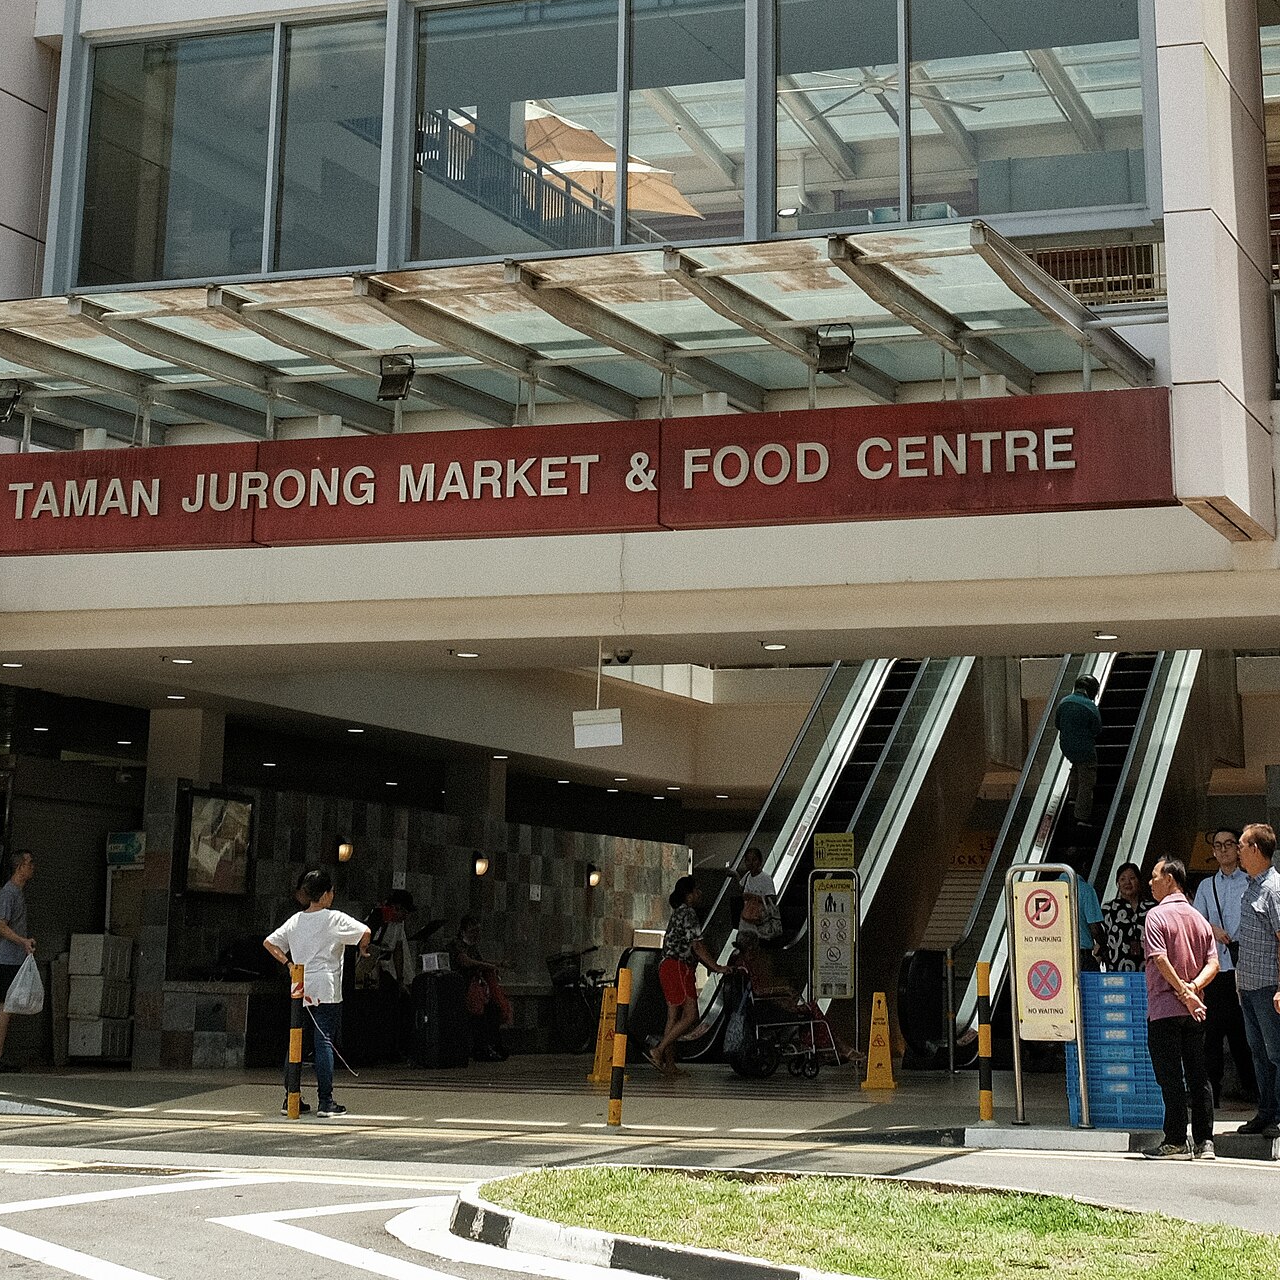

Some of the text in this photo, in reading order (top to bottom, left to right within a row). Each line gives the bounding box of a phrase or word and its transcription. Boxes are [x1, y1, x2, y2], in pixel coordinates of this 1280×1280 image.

[8, 426, 1077, 520] TAMAN JURONG MARKET & FOOD CENTRE
[1034, 935, 1062, 943] PARKING
[1038, 1007, 1064, 1015] WAITING
